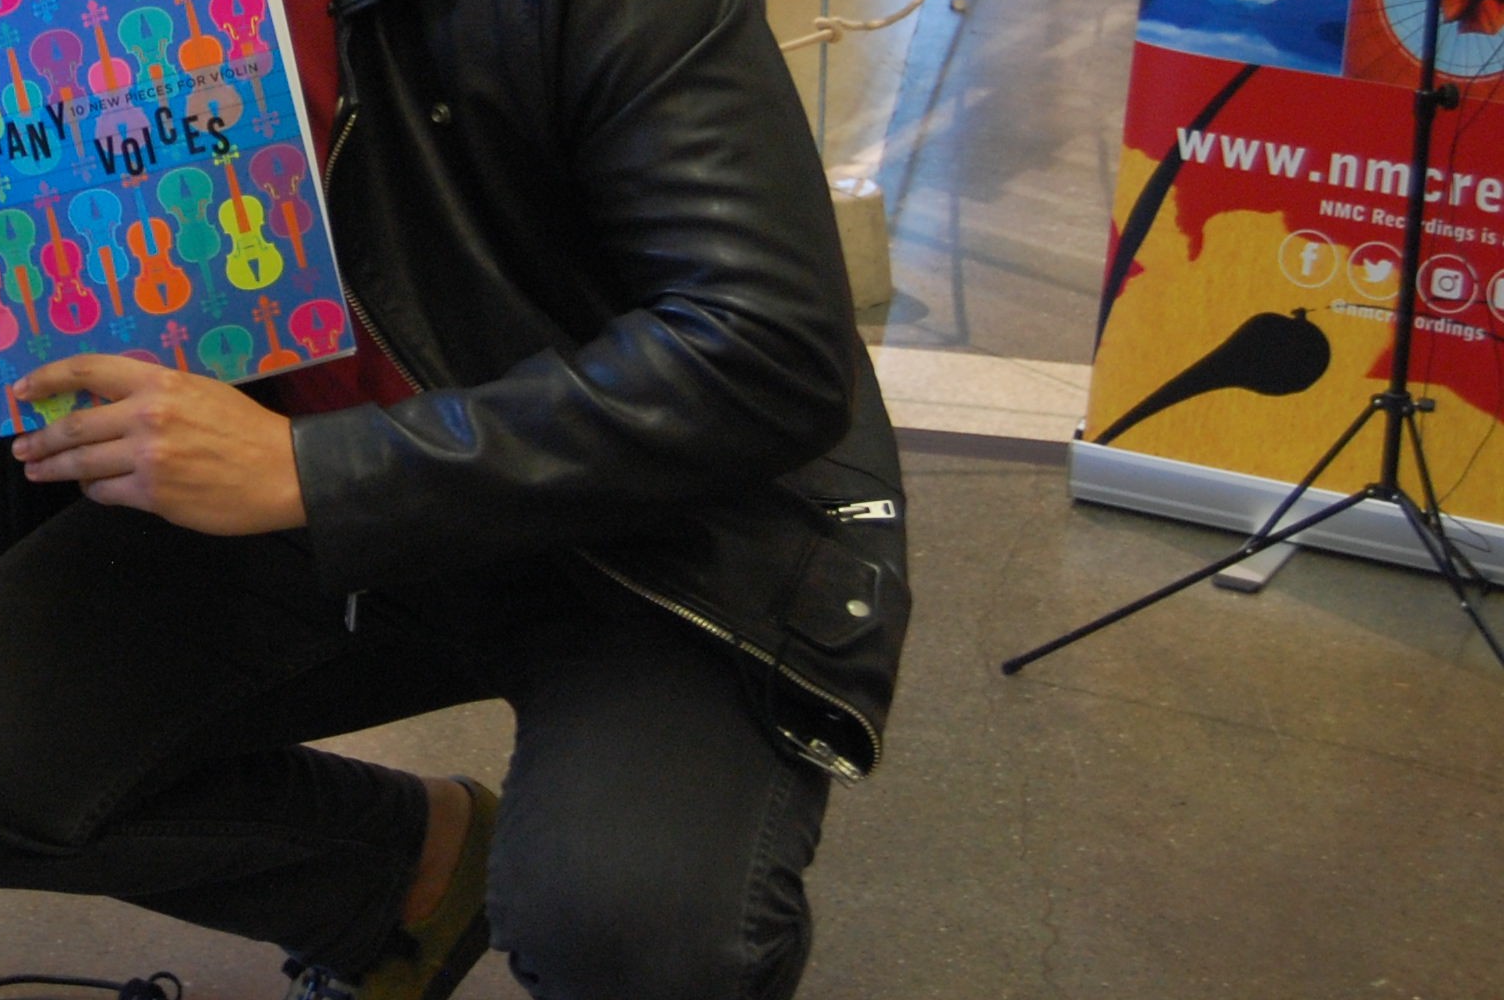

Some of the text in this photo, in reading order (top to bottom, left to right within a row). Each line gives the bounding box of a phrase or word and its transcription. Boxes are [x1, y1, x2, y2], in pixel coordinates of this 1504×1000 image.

[70, 62, 258, 117] 10 NEW PIECES FOR VIOLIN
[94, 106, 231, 177] VOICES
[1319, 200, 1496, 245] NMC Recdings is
[1330, 297, 1486, 342] @nmcrordings
